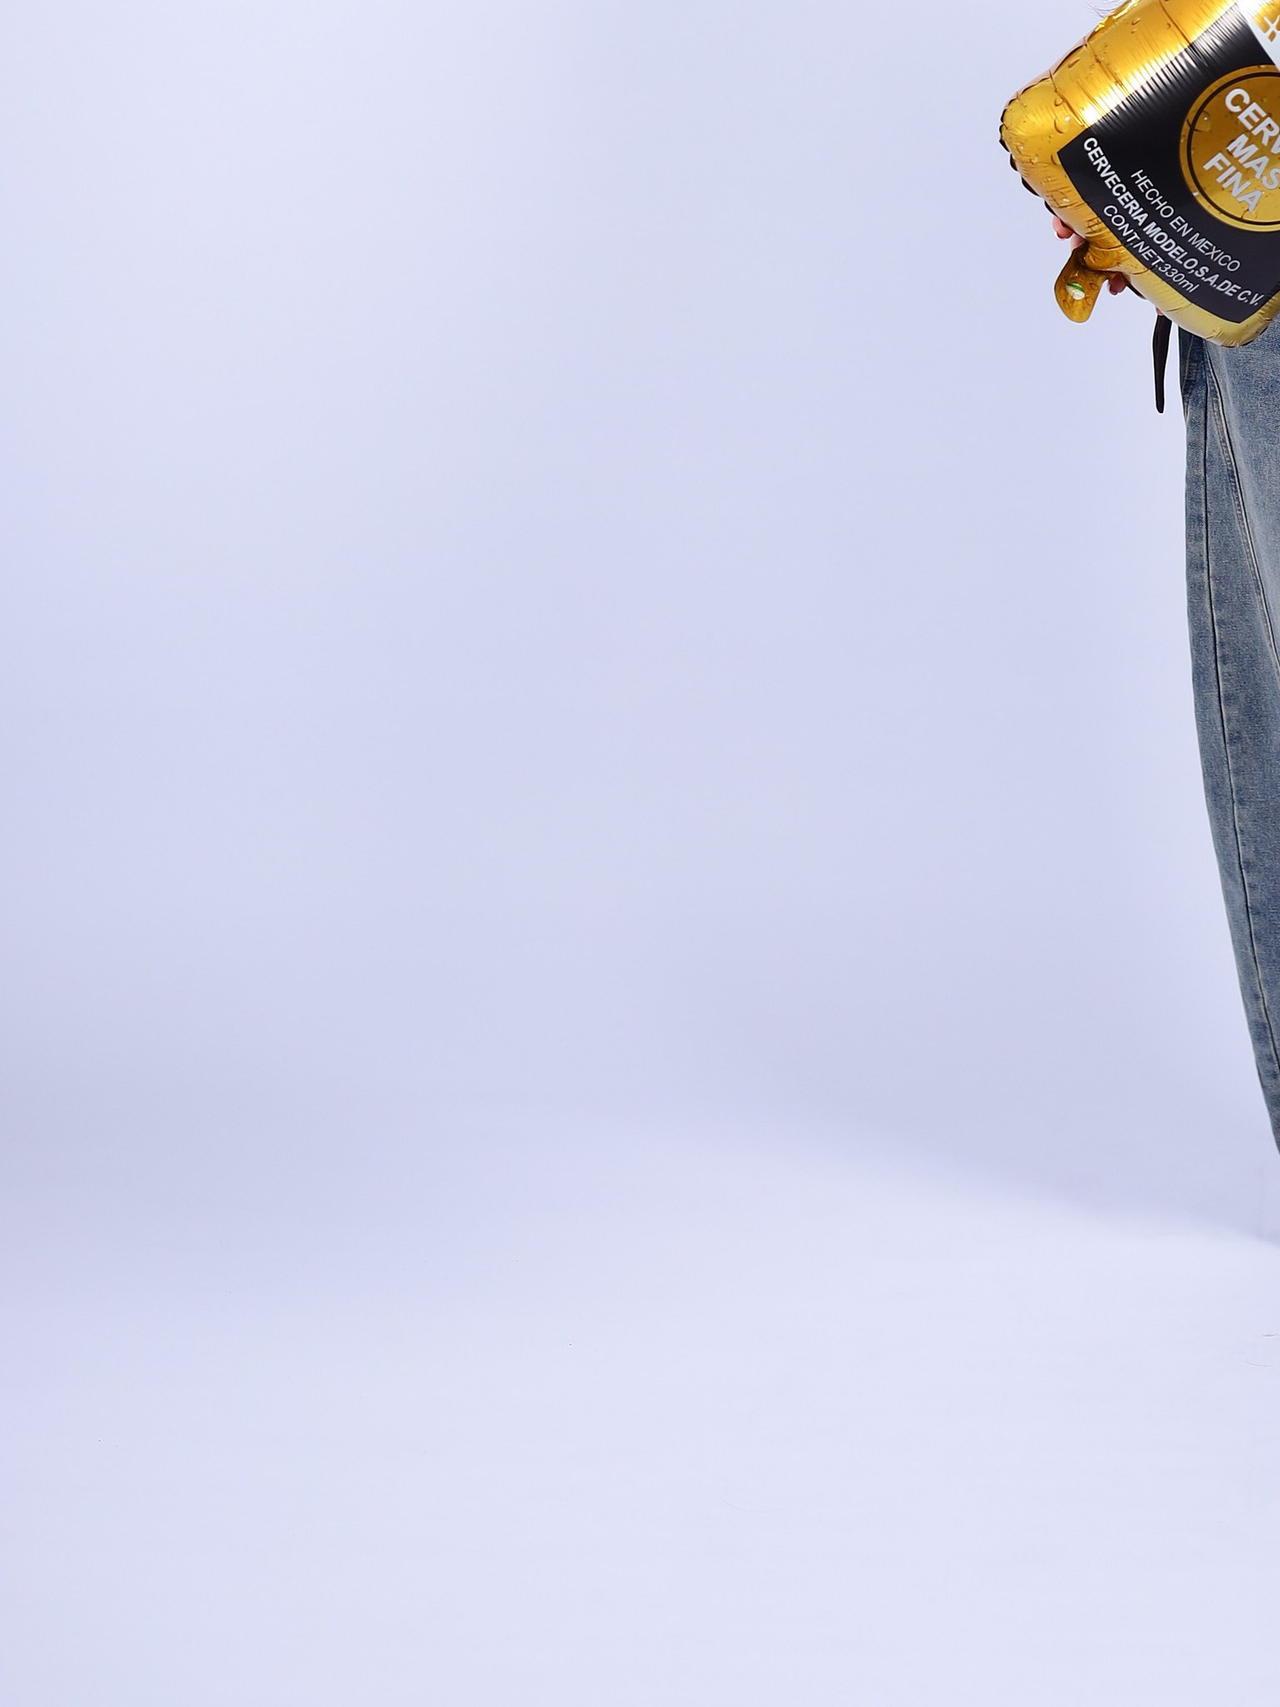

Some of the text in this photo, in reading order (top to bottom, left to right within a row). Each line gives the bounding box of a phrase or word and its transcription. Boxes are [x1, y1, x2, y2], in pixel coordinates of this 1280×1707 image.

[1083, 137, 1149, 226] CERVECERIA
[1130, 169, 1241, 273] HECHO EN MEXICO
[1203, 152, 1264, 213] FINA
